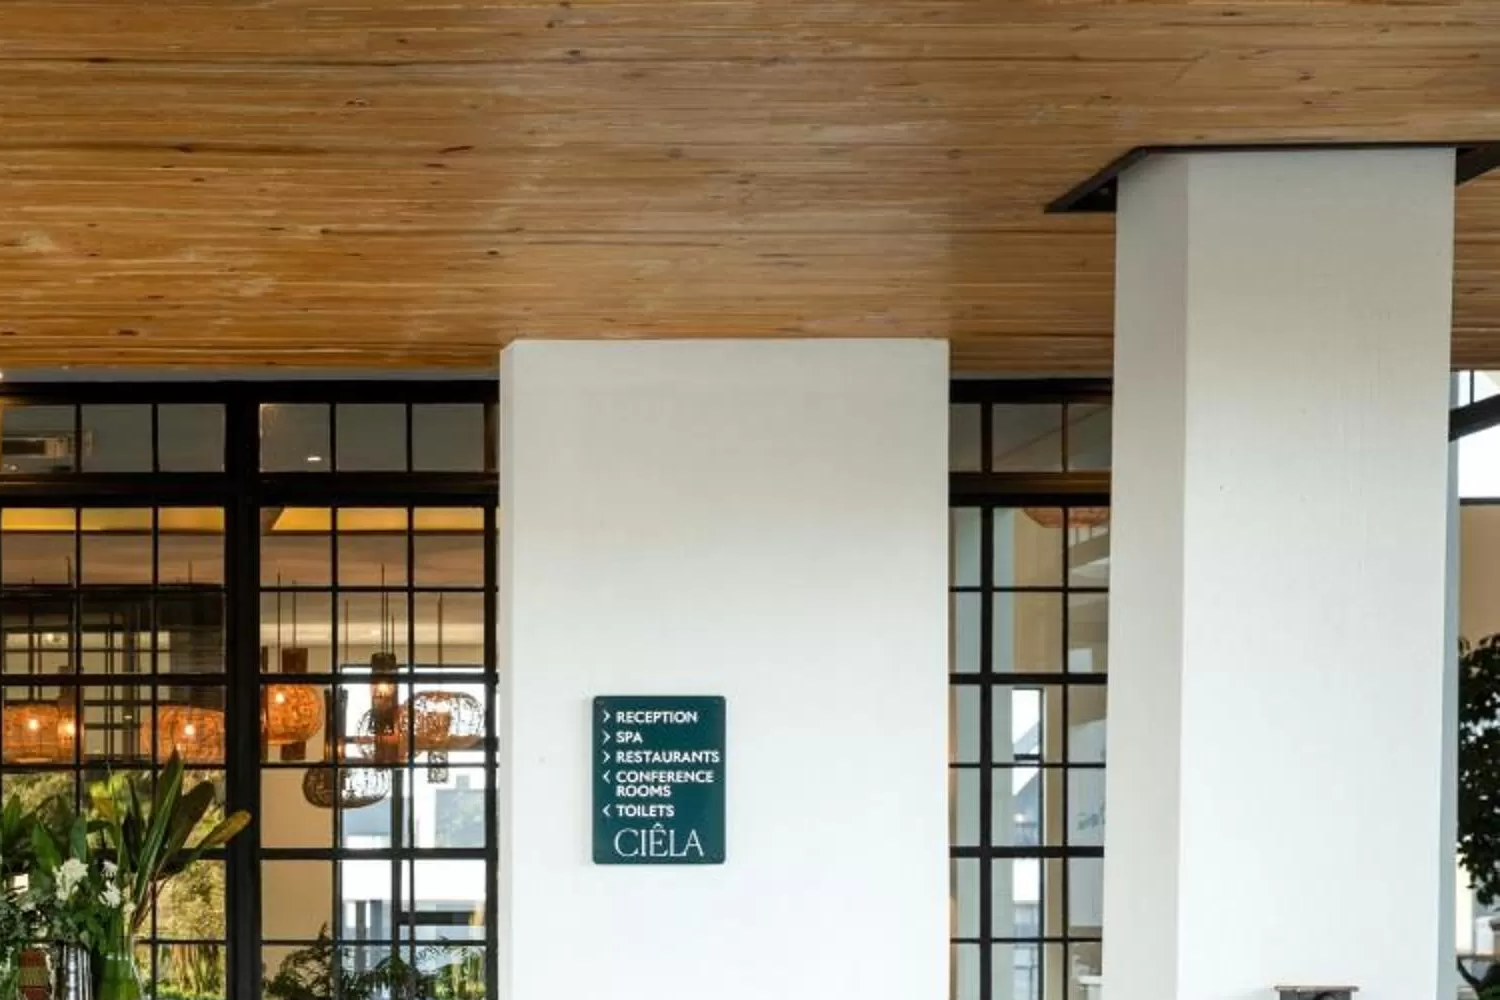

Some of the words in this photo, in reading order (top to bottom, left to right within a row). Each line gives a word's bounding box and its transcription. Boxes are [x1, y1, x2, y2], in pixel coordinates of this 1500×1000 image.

[615, 711, 699, 724] RECEPTION
[615, 731, 643, 744] SPA
[615, 751, 720, 764] RESTAURANTS
[615, 770, 715, 783] CONFERENCE
[615, 785, 671, 798] ROOMS
[615, 804, 675, 817] TOILETS
[613, 821, 705, 857] CIÊLA
